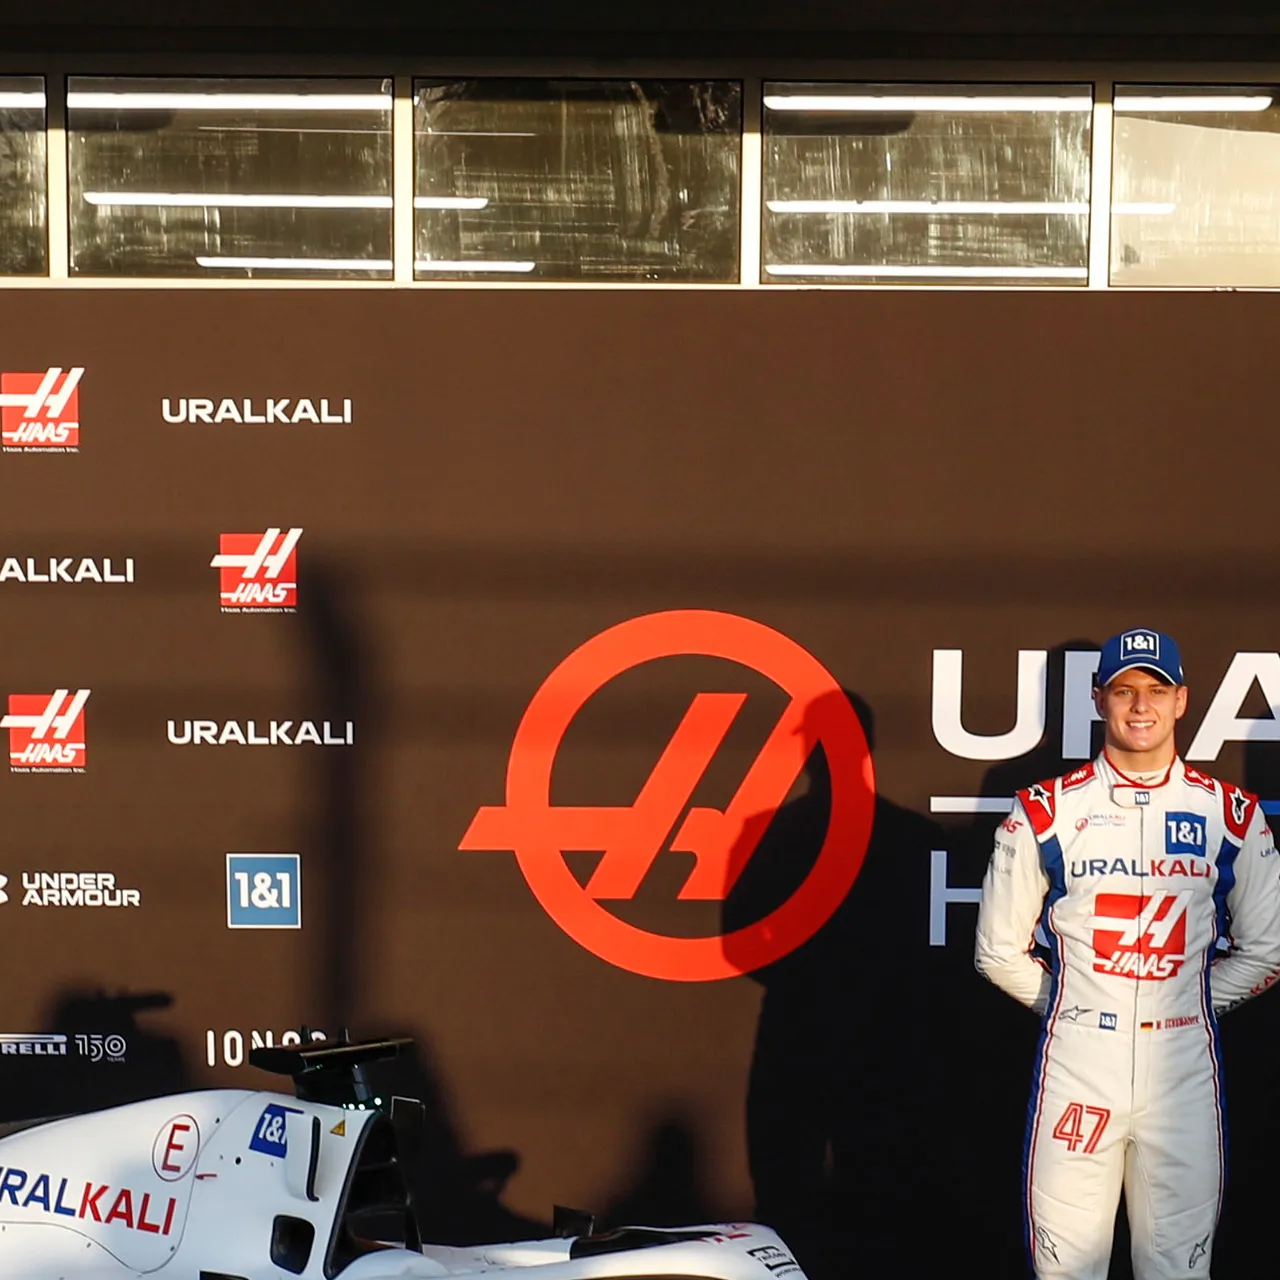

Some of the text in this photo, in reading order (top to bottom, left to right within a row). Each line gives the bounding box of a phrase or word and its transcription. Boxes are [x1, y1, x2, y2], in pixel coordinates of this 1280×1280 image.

[163, 399, 351, 423] URALKALI
[2, 422, 78, 442] HAAS
[221, 583, 296, 602] HAAS
[1124, 634, 1155, 651] 1&1
[168, 721, 353, 744] URALKALI
[10, 743, 85, 763] HAAS
[1167, 820, 1203, 846] 1&1
[1070, 857, 1212, 878] URALKALI
[21, 872, 116, 890] UNDER
[234, 871, 291, 909] 1&1
[21, 889, 140, 907] ARMOUR
[1093, 950, 1186, 978] HAAS
[1051, 1101, 1112, 1155] 47
[162, 1123, 193, 1173] E
